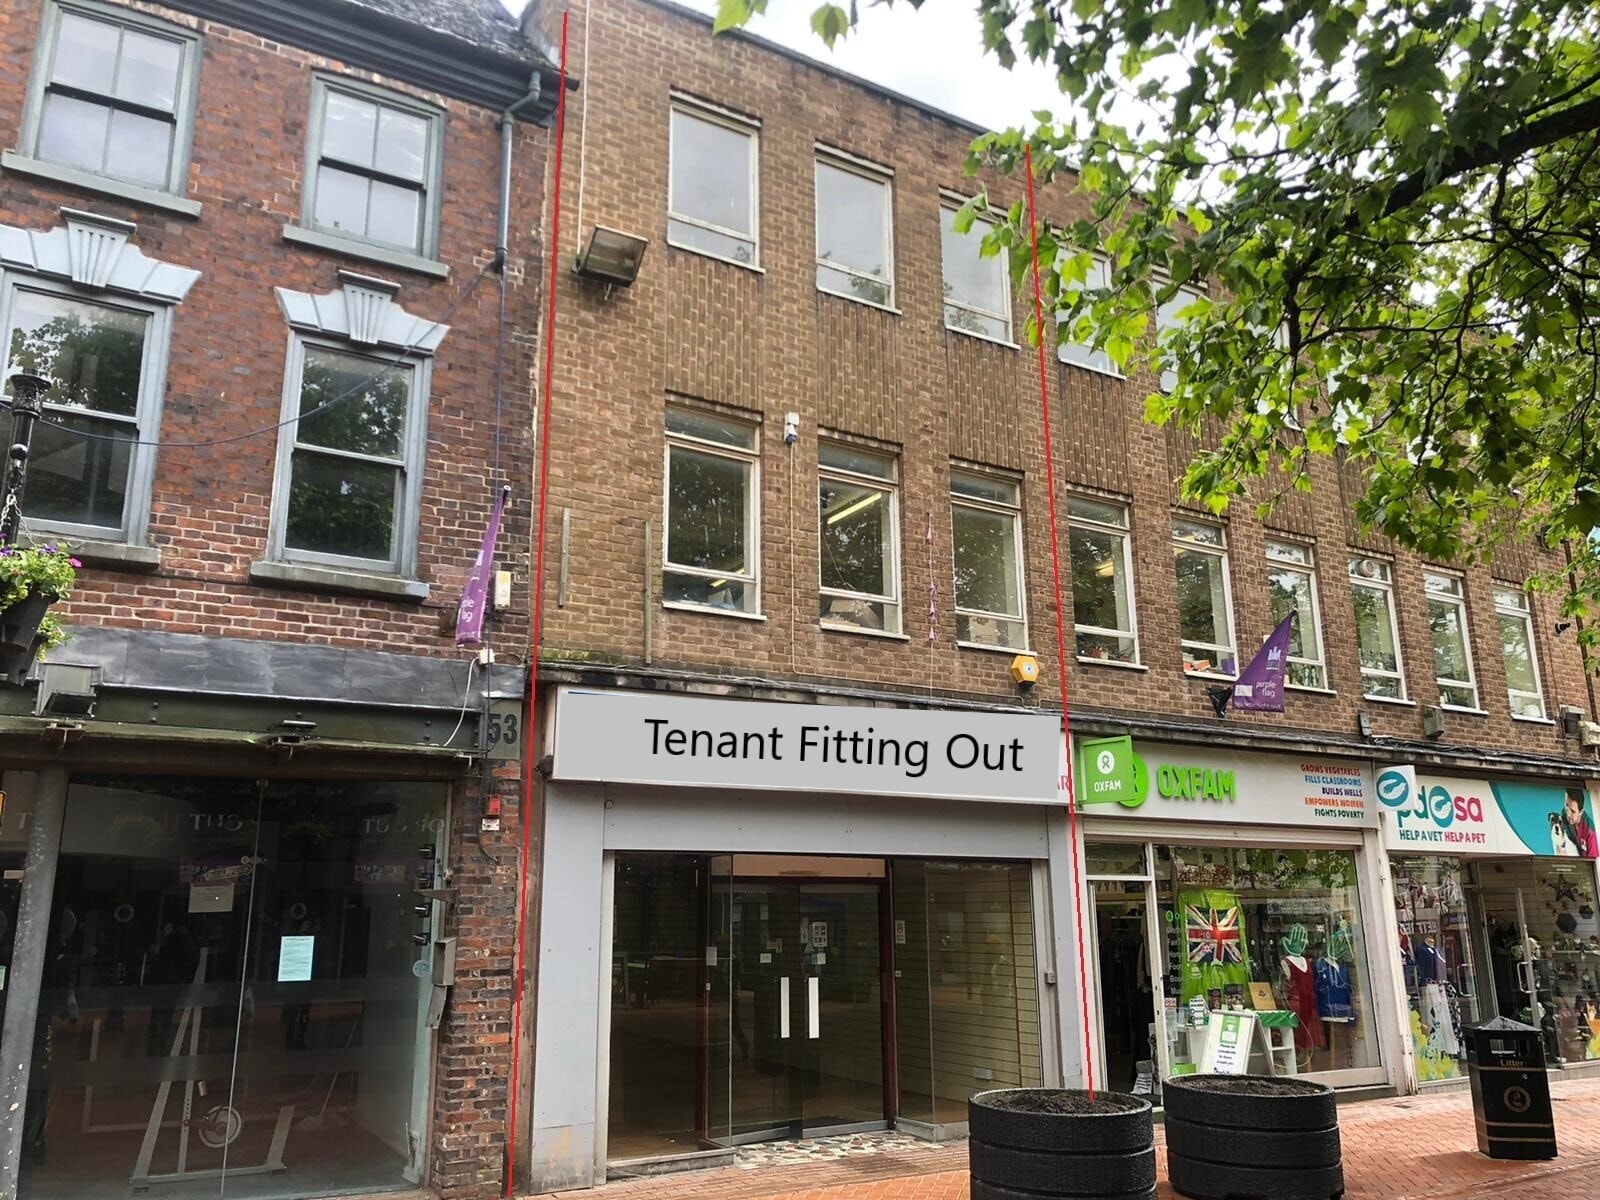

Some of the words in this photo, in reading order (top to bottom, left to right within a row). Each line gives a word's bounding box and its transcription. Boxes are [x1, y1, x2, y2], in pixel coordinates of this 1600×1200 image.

[1255, 681, 1276, 690] purple
[1261, 688, 1275, 698] flag
[487, 713, 518, 745] 53
[1301, 764, 1324, 774] GROWS
[1324, 766, 1361, 776] VEGETABLES
[1094, 779, 1122, 793] OXFAM
[1157, 763, 1236, 801] OXFAM
[1304, 775, 1321, 784] FILLS
[1321, 776, 1362, 786] CLASSROOMS
[1322, 787, 1343, 796] BUILDS
[1344, 789, 1363, 797] WELLS
[1305, 797, 1339, 807] EMPOWERS
[1340, 799, 1364, 808] WOMEN
[1314, 808, 1337, 818] FIGHTS
[1338, 810, 1365, 819] POVERTY
[1399, 829, 1420, 841] HELP
[1421, 831, 1428, 841] A
[1428, 831, 1443, 842] VET
[1444, 831, 1465, 843] HELP
[1465, 833, 1472, 843] A
[1472, 833, 1486, 844] PET
[1500, 1058, 1524, 1067] Litter
